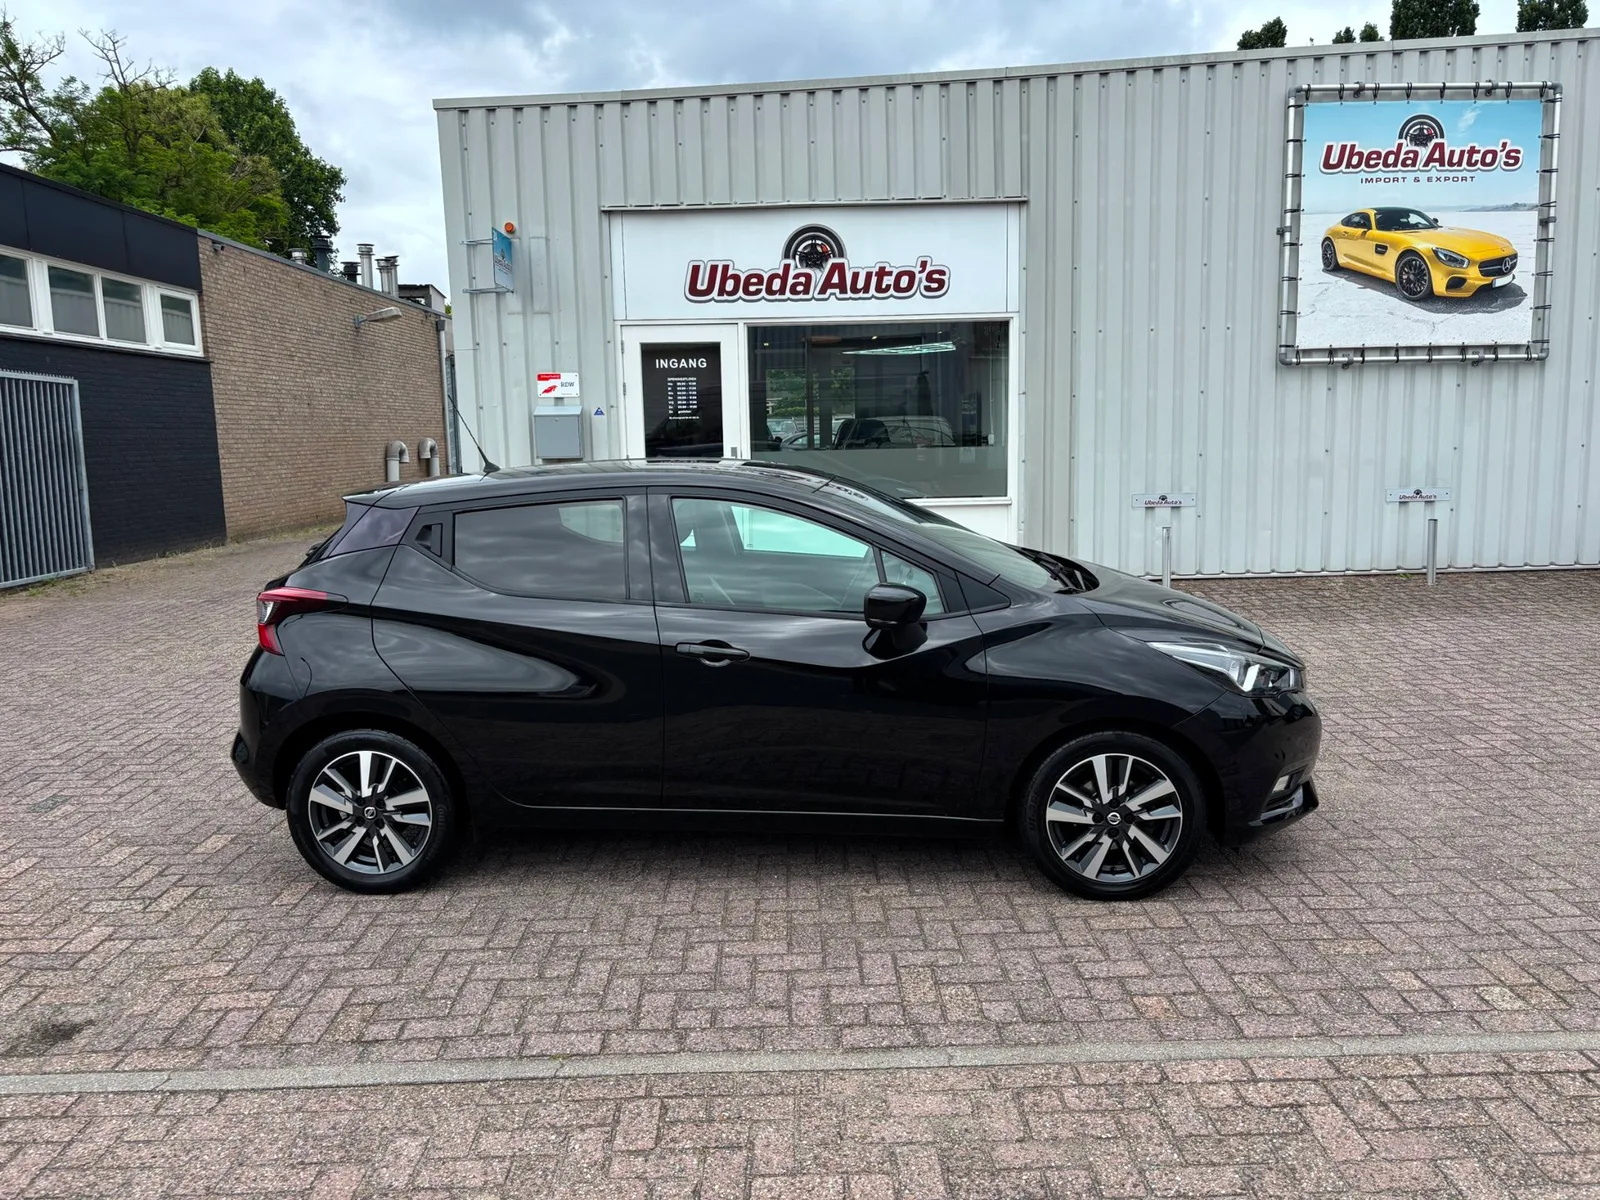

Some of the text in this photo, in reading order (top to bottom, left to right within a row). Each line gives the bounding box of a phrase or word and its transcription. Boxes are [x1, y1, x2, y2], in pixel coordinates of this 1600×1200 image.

[1321, 141, 1522, 171] Ubeda Auto's
[1360, 175, 1476, 184] IMPORT & EXPORT
[687, 259, 948, 298] Ubeda Auto's
[655, 358, 707, 369] INGANG
